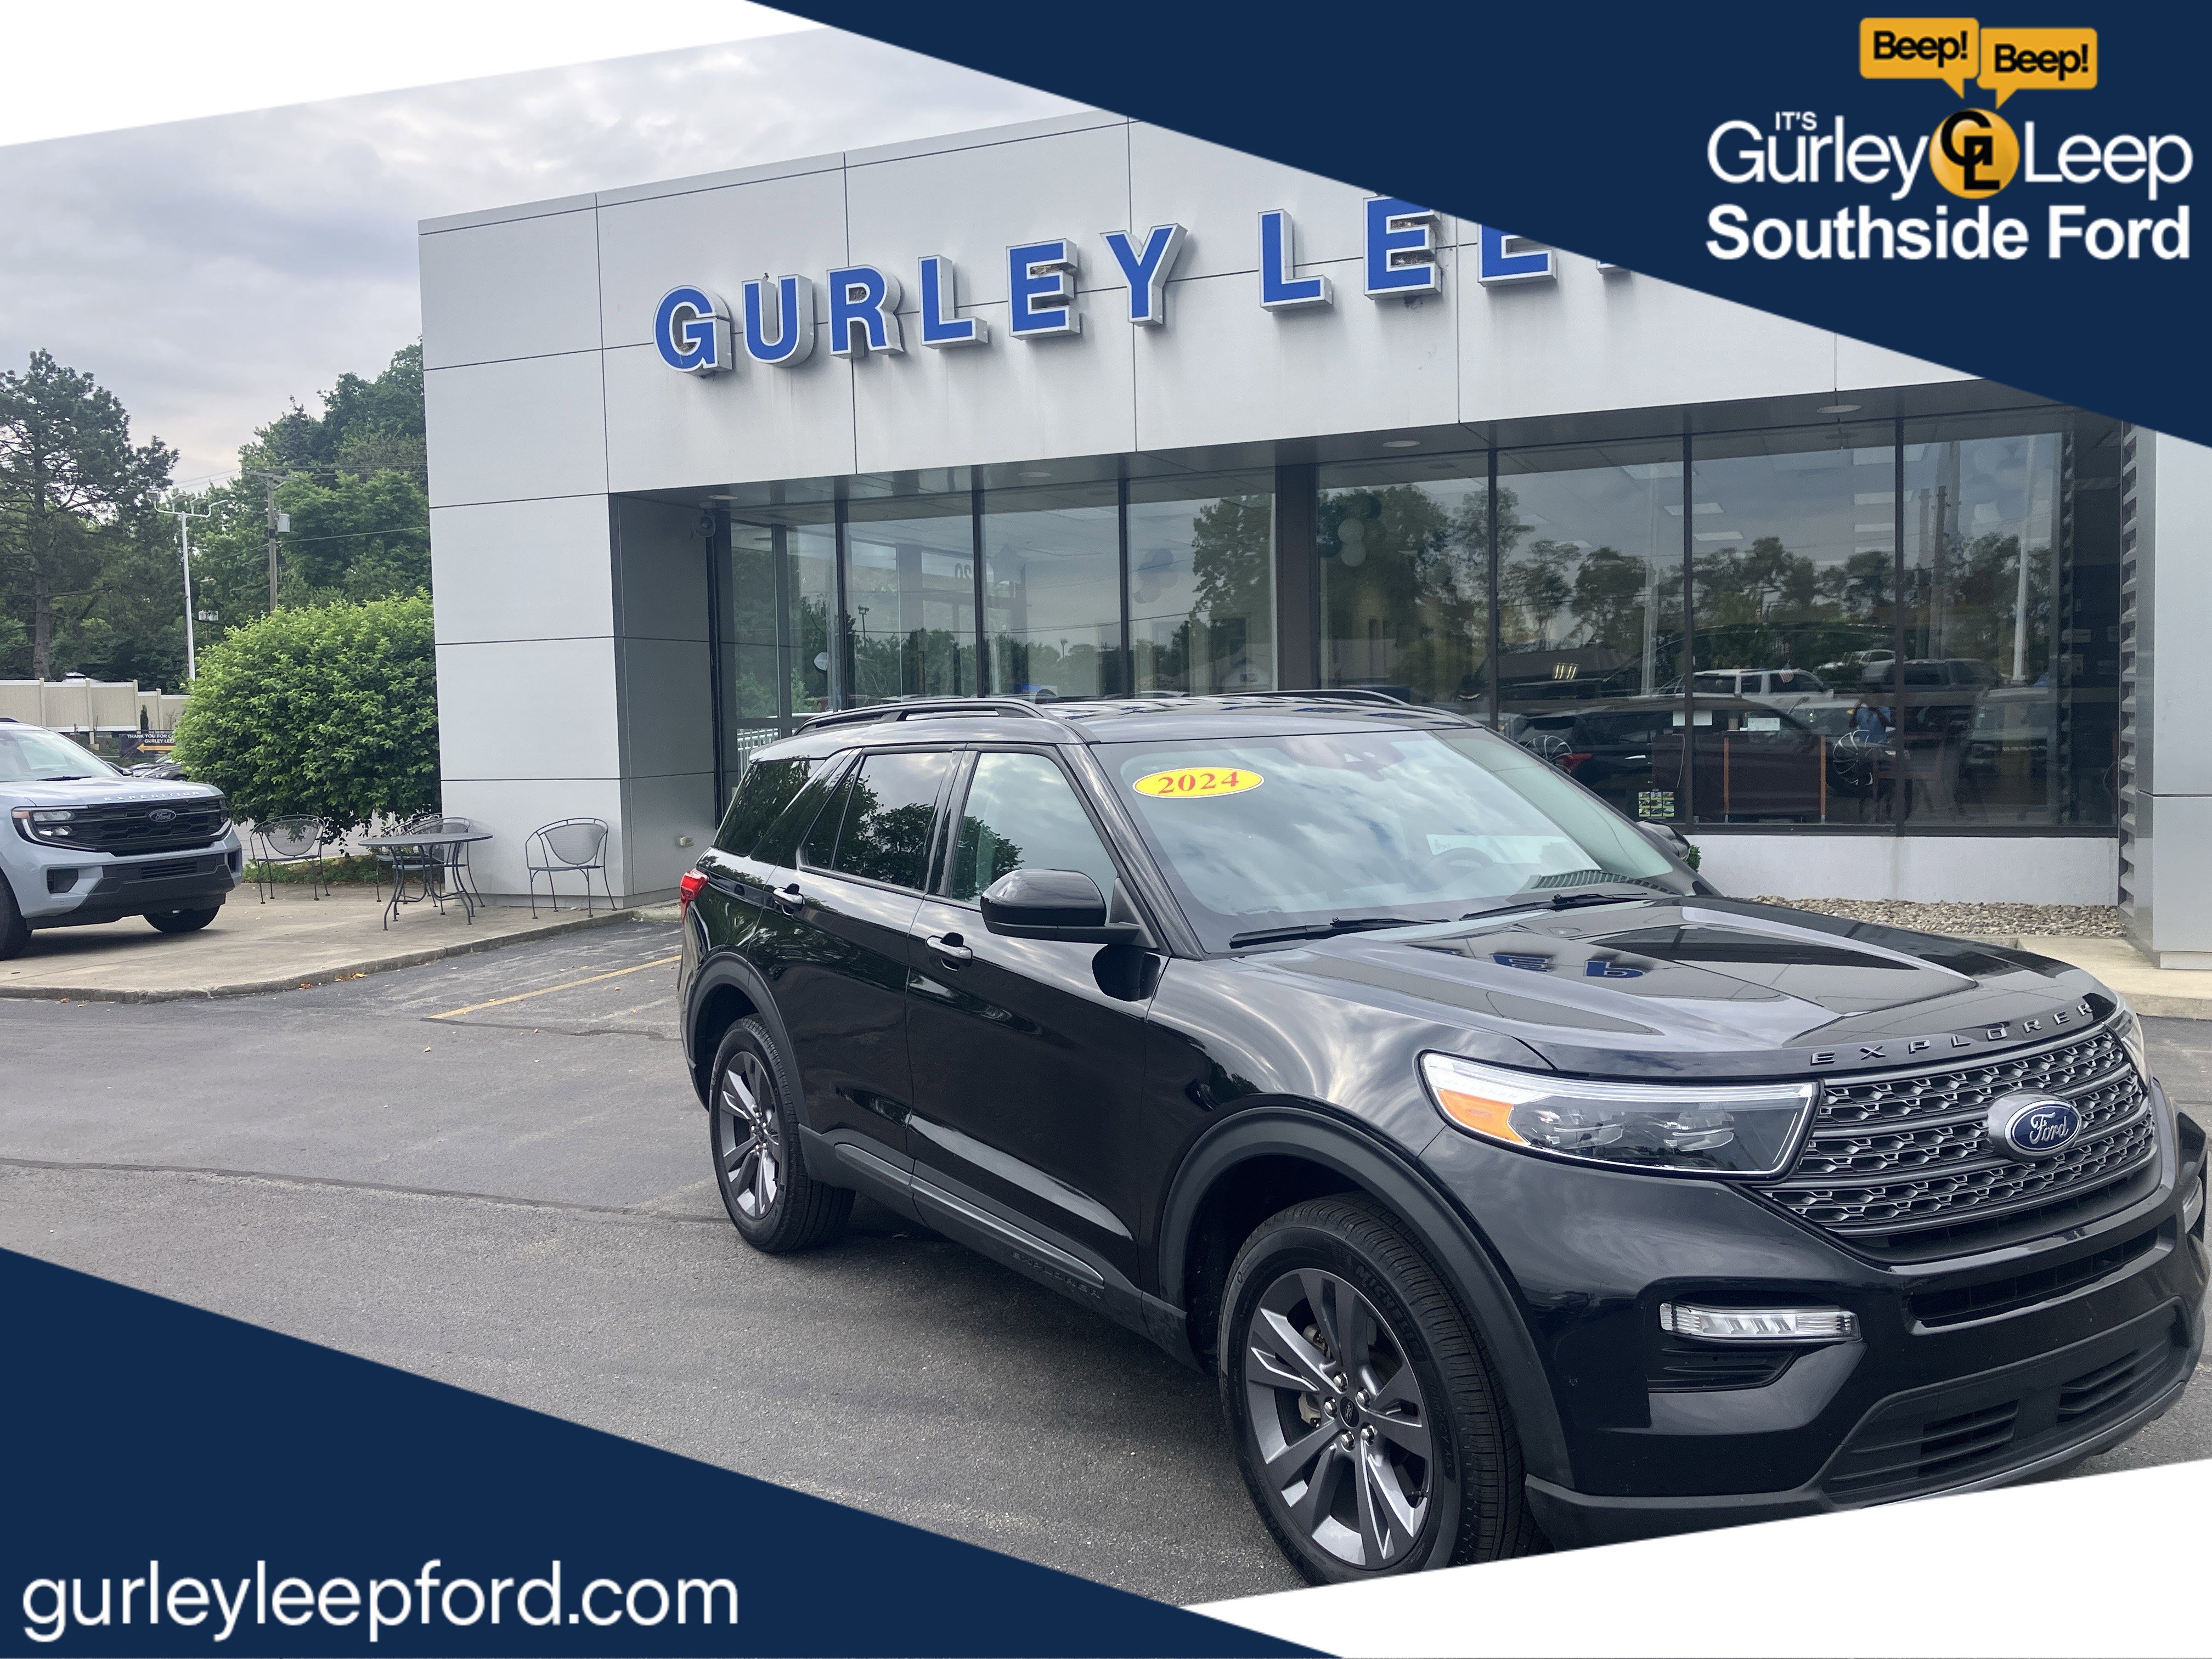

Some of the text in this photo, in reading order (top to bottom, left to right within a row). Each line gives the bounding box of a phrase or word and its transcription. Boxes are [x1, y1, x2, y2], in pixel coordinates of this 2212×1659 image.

[653, 195, 1630, 375] GURLEY LEE
[104, 791, 200, 802] EXPEDITION
[1158, 771, 1239, 794] 2024
[155, 812, 172, 821] Ford
[1811, 1002, 2094, 1065] EXPLORER
[2029, 1112, 2070, 1146] Ford
